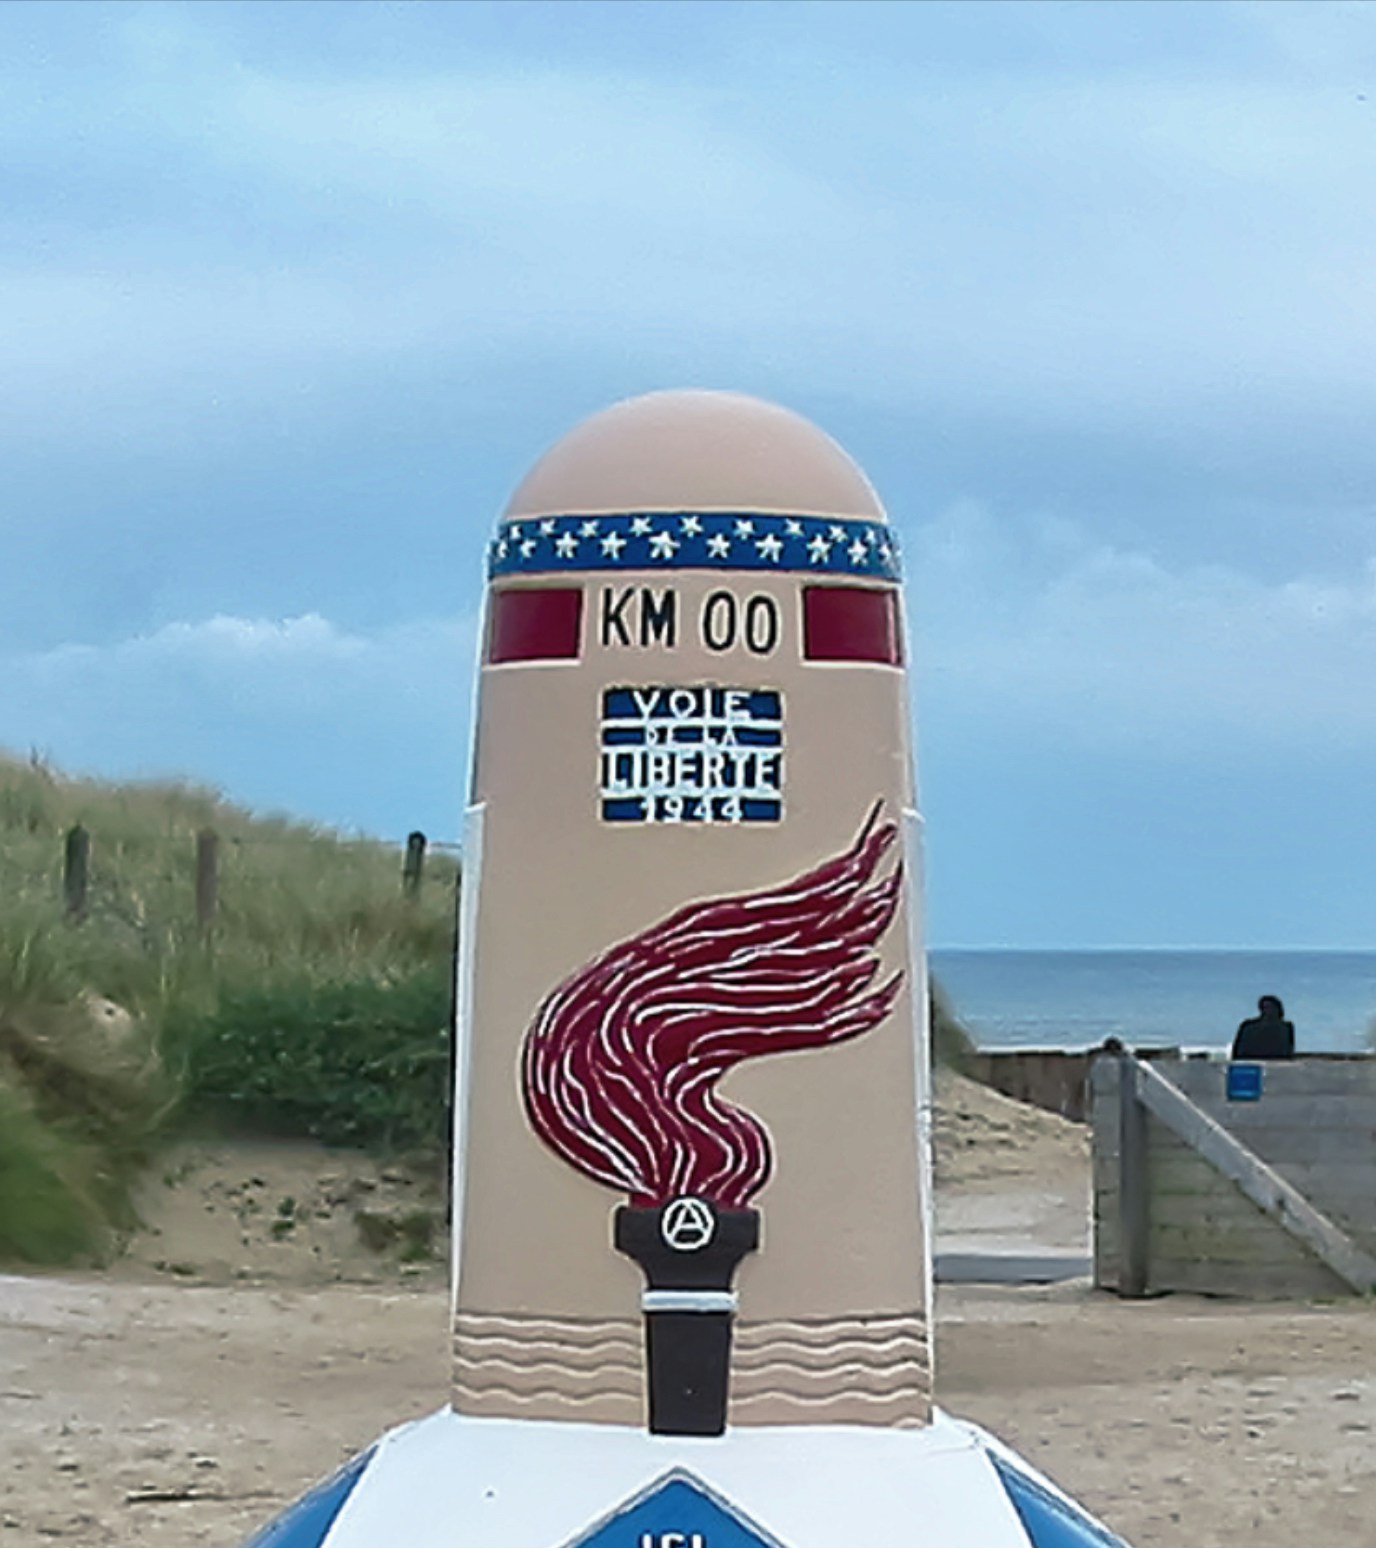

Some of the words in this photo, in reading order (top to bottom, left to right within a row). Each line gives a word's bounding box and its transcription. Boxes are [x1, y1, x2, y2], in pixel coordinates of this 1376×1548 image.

[601, 586, 676, 648] KM
[633, 688, 751, 719] VOIE
[646, 726, 674, 747] DE
[703, 726, 737, 747] LA
[640, 796, 743, 823] 1944
